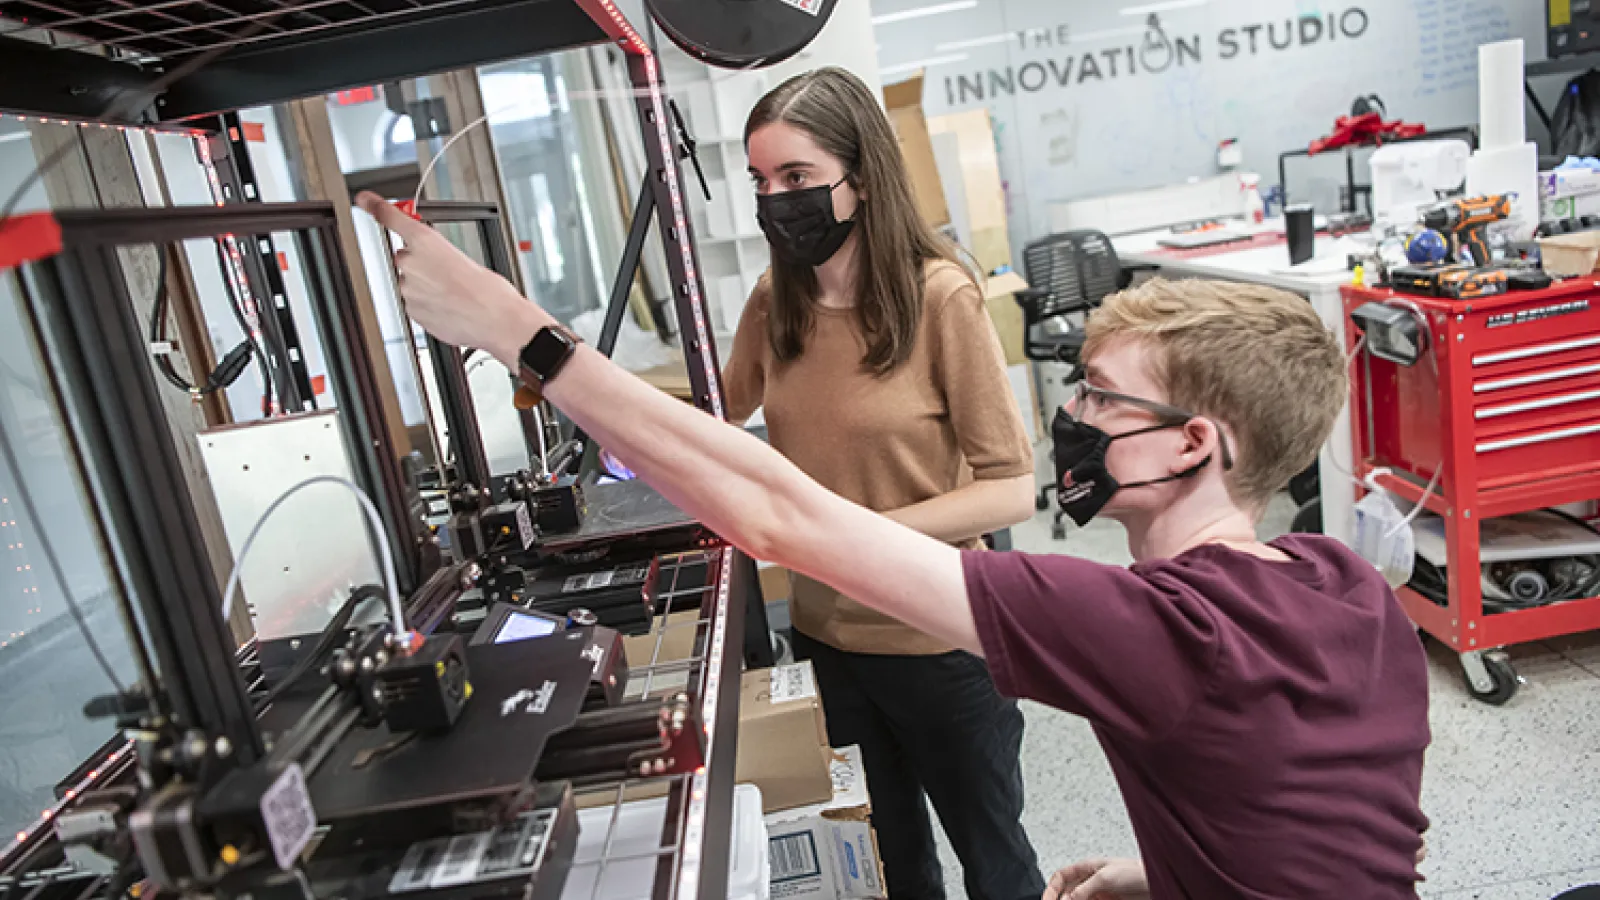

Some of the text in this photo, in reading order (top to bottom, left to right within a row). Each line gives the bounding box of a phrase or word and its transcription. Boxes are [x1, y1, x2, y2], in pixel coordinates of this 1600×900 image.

[944, 12, 1202, 106] INNOVATION
[1217, 6, 1369, 60] STUDIO
[1016, 23, 1070, 50] THE
